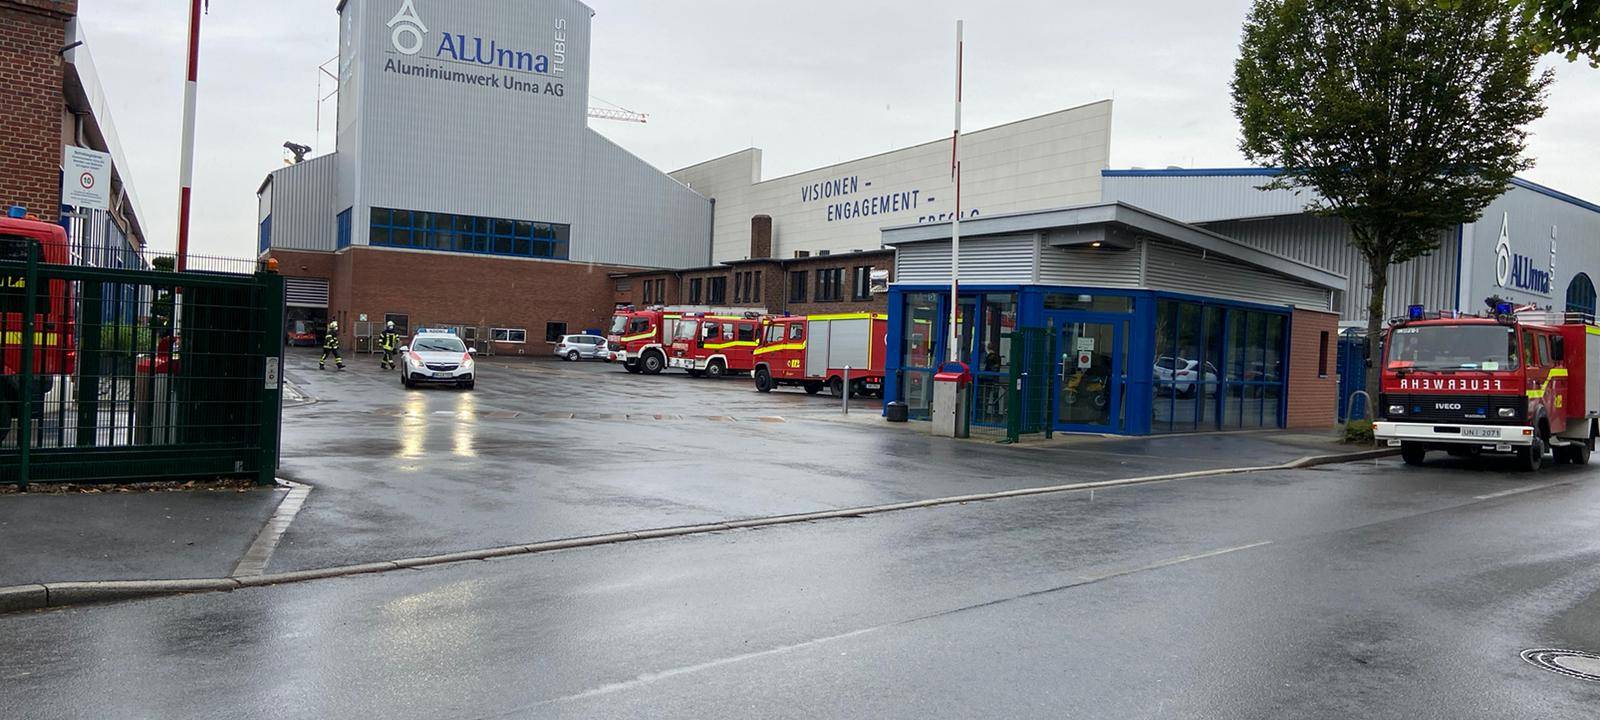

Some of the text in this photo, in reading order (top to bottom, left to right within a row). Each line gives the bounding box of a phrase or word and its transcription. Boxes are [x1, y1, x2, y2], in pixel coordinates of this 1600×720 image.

[436, 32, 549, 73] ALUnna
[553, 18, 566, 74] TUBES
[384, 58, 564, 97] Aluminiumwerk Unna AG
[801, 176, 858, 203] VISIONEN
[827, 190, 920, 222] ENGAGEMENT
[1510, 254, 1549, 294] ALUnna
